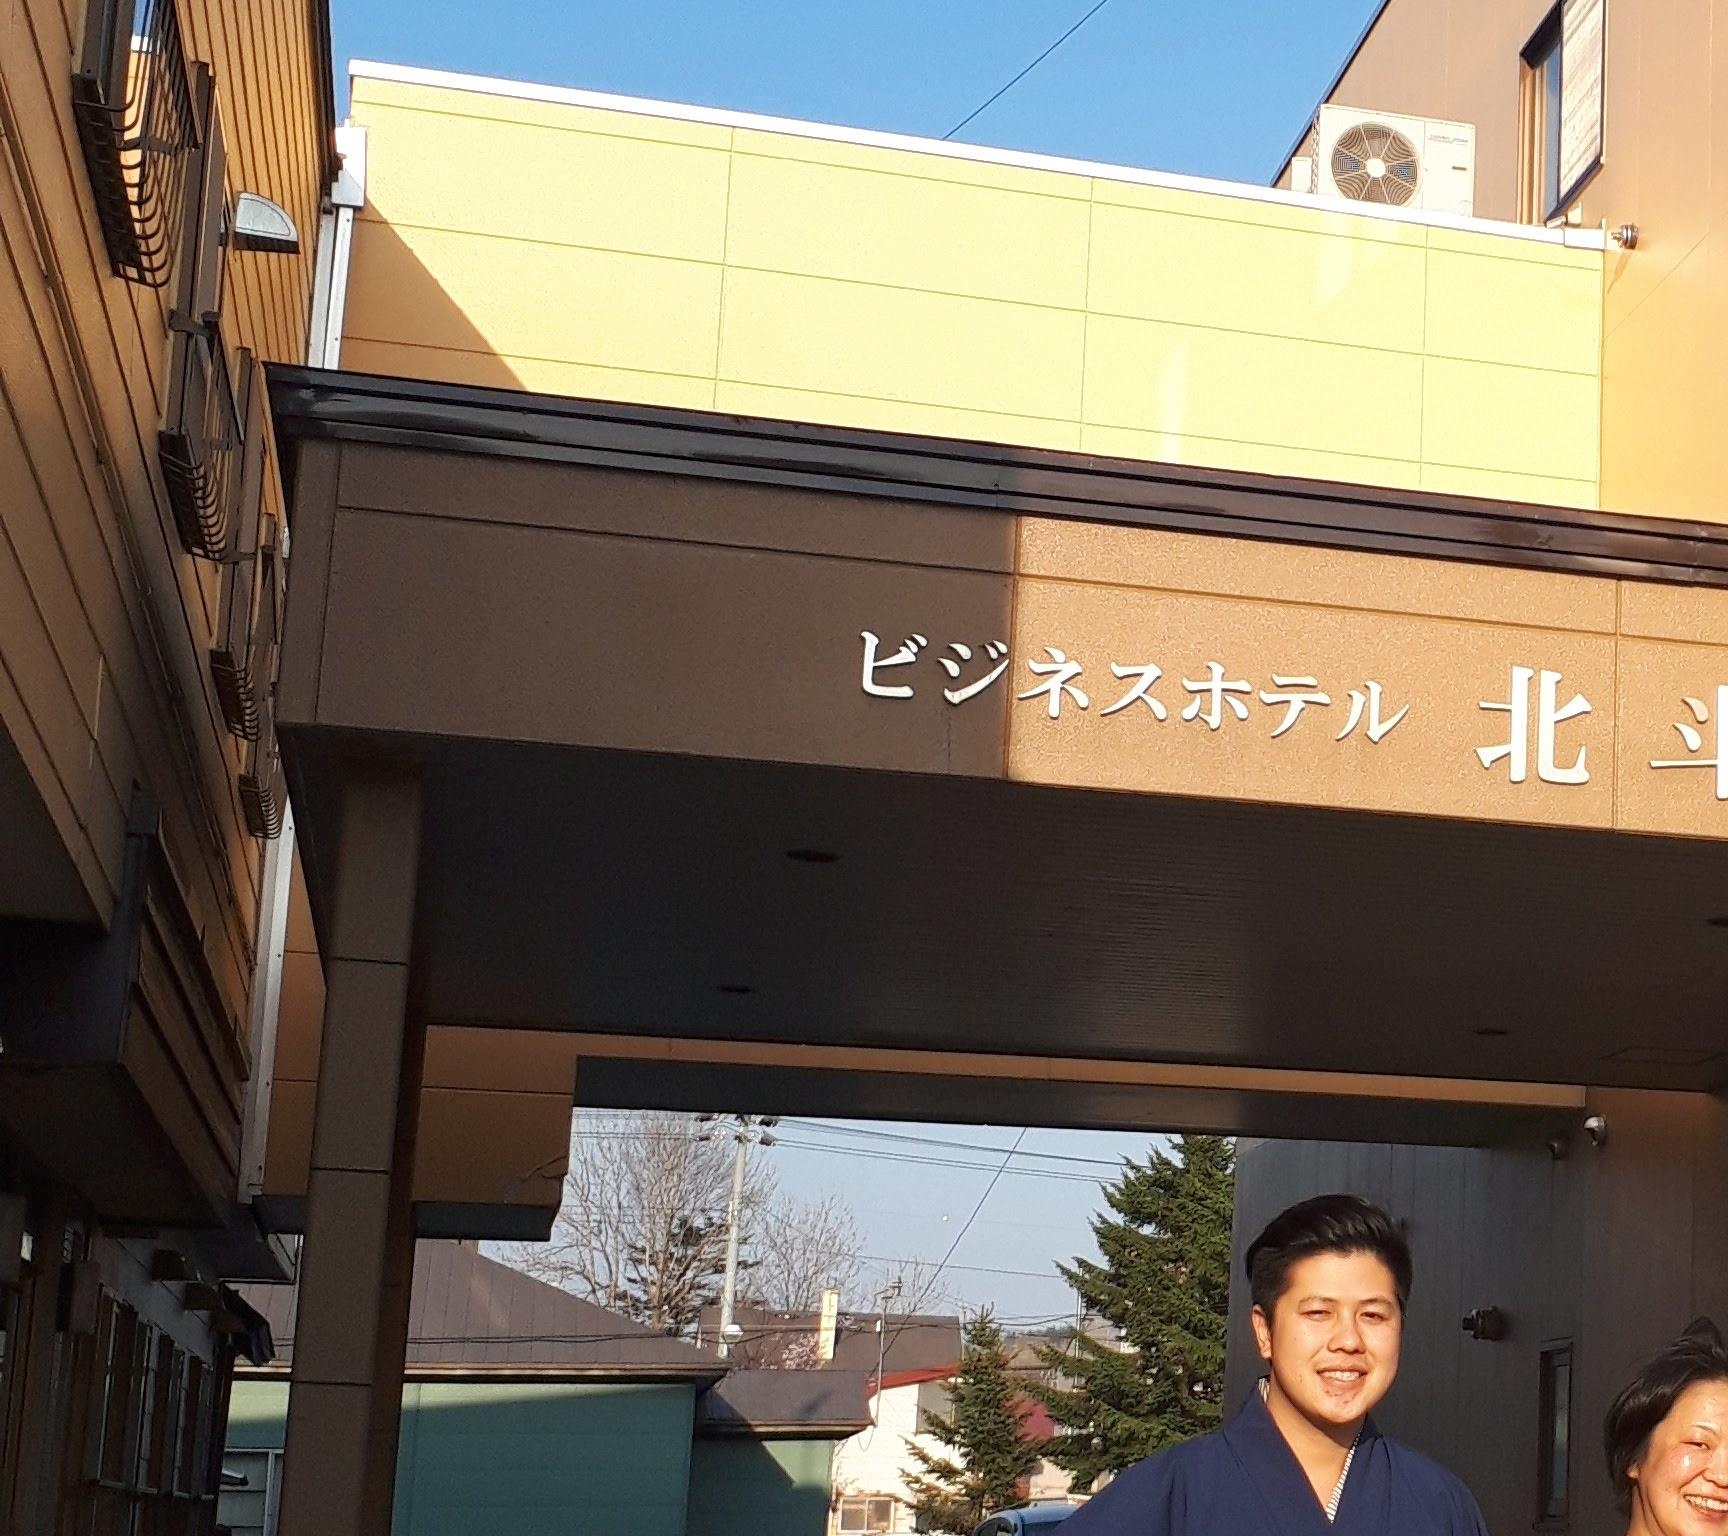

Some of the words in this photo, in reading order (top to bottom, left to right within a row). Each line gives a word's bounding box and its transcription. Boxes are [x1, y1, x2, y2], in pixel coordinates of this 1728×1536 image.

[859, 630, 1410, 743] ビジネスホテル
